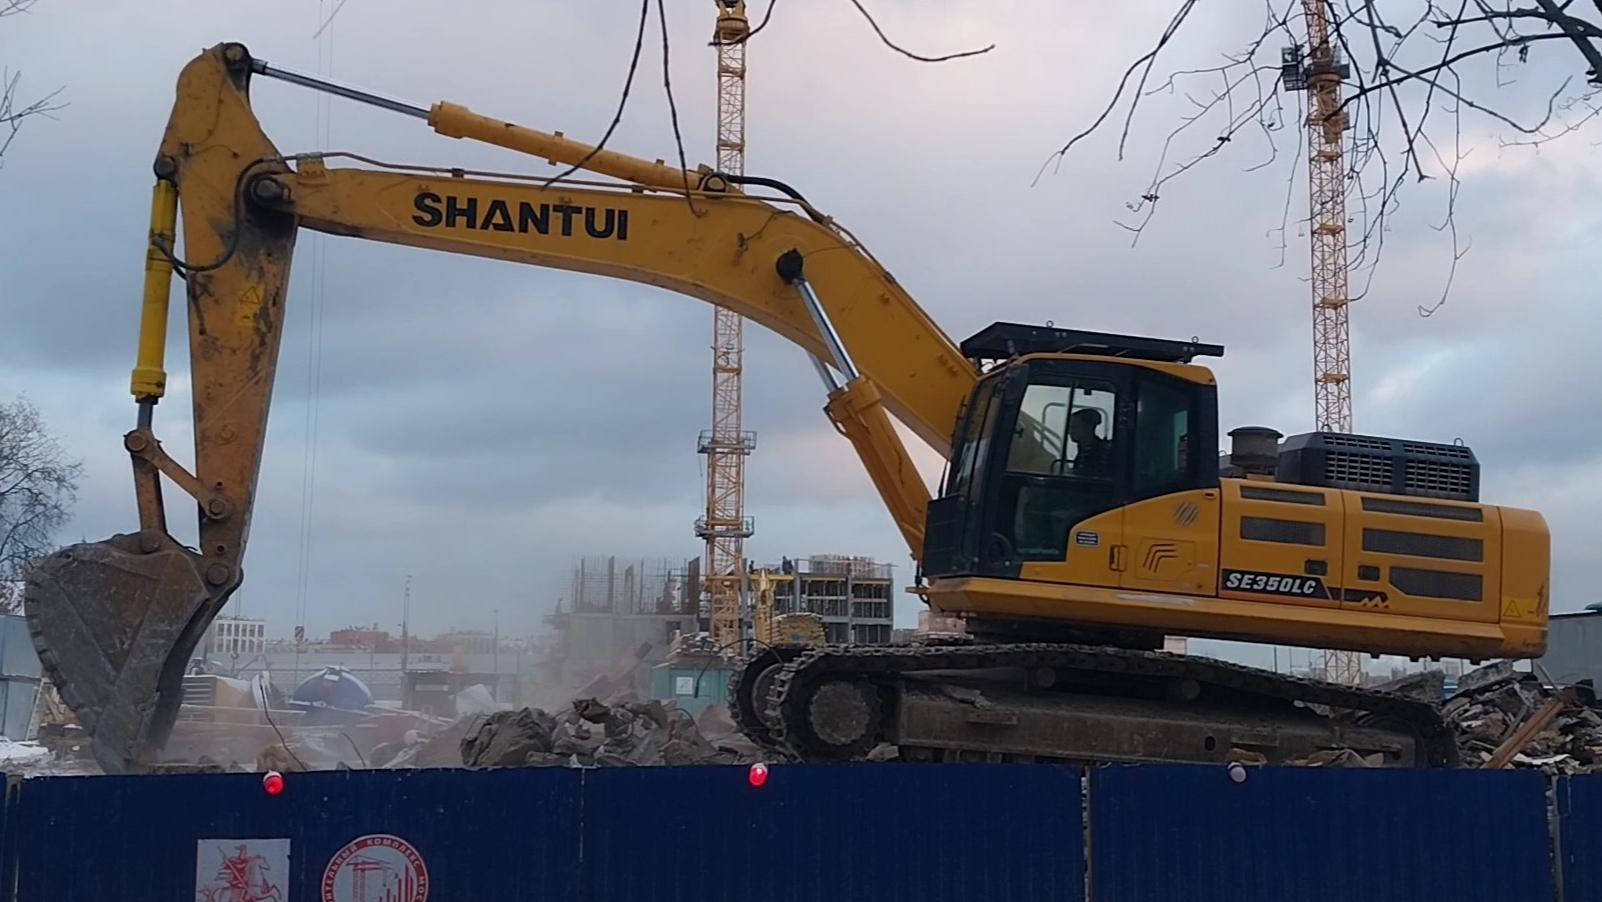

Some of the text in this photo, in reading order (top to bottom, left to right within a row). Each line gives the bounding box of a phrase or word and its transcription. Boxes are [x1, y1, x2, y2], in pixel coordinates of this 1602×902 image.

[411, 192, 628, 241] SHANTUI
[1226, 572, 1317, 595] SE350LC
[325, 844, 357, 902] ИТЕЛЬНЫЙ
[366, 838, 420, 867] КОМПЛЕКС
